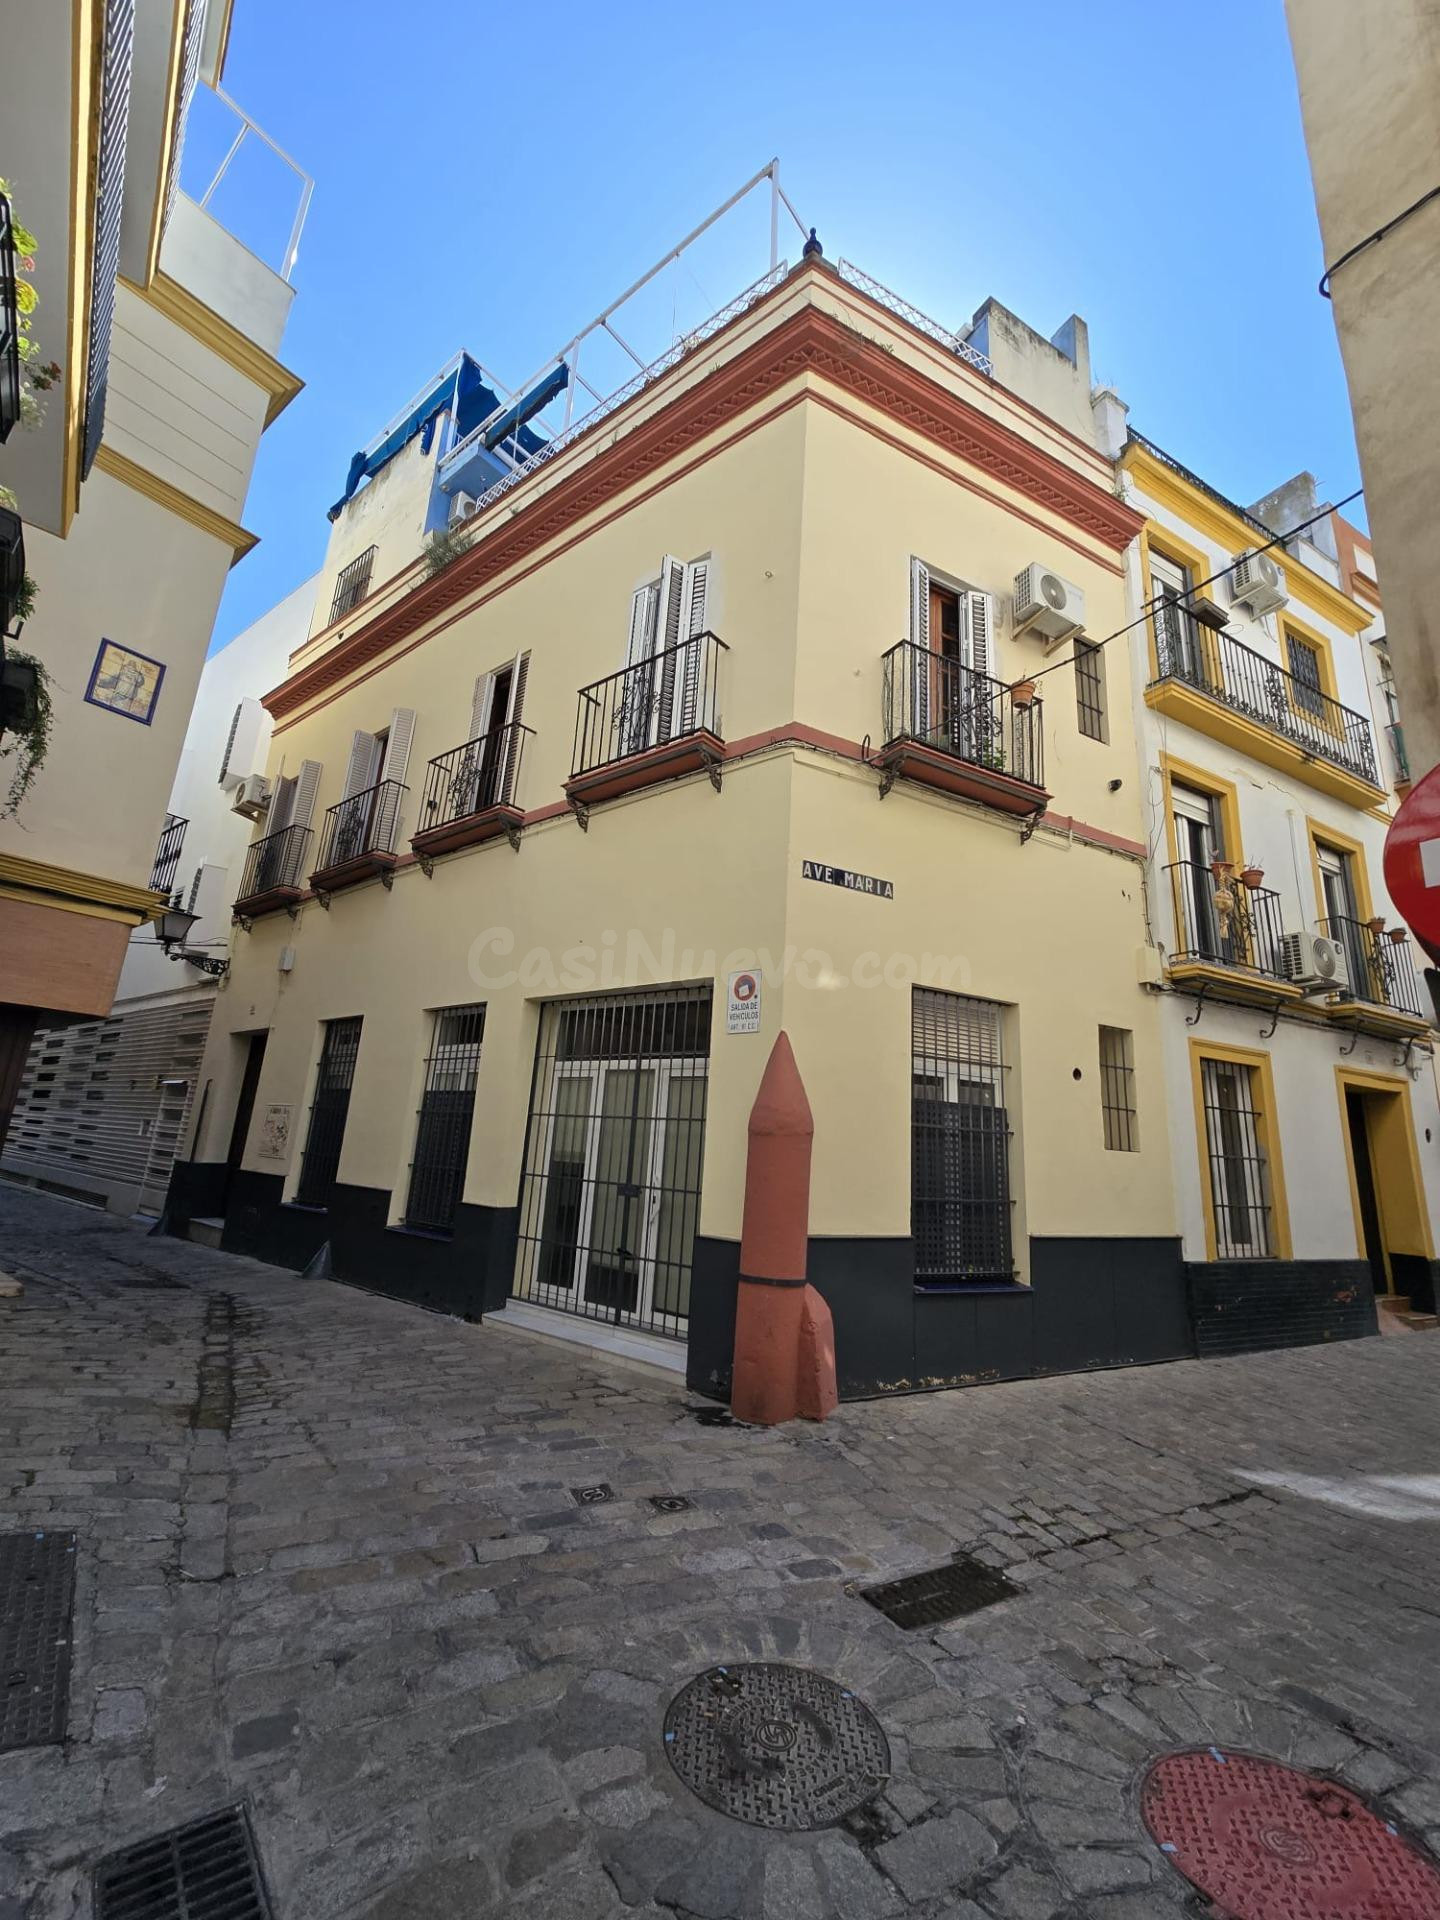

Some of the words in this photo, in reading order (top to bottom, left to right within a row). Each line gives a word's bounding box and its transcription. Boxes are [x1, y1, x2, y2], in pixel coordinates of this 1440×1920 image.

[803, 862, 833, 882] AVE
[844, 872, 893, 897] MARIA
[730, 1002, 749, 1011] SALIDA
[750, 1001, 758, 1010] DE
